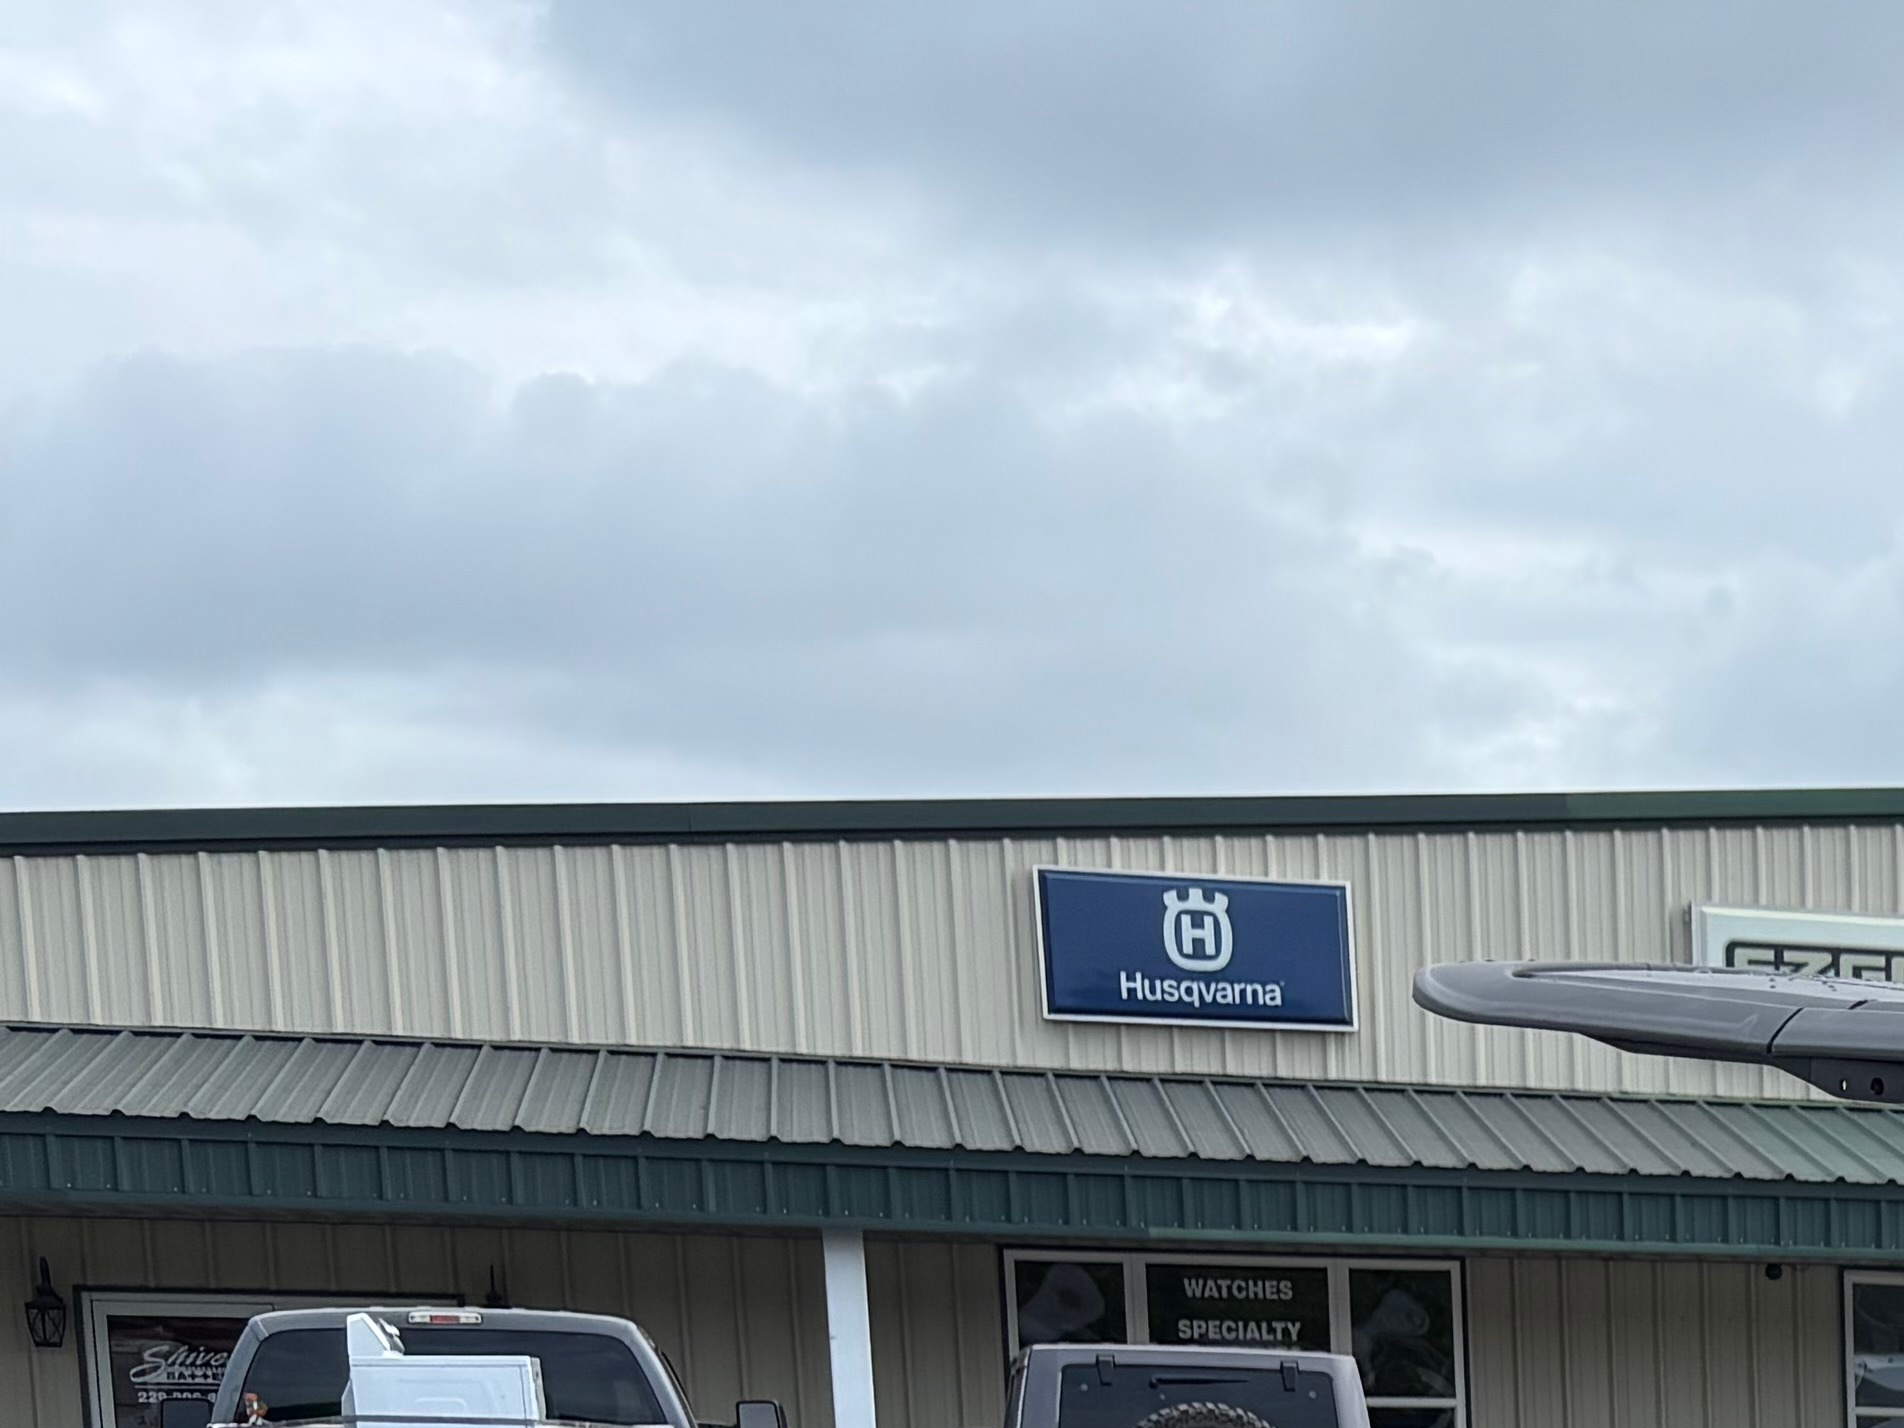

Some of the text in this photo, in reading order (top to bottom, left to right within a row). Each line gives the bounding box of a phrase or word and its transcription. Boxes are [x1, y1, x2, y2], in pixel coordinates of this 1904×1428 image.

[1119, 970, 1283, 1008] Husqvarna
[1183, 1277, 1294, 1300] WATCHES
[1177, 1318, 1301, 1342] SPECIALTY
[130, 1345, 228, 1383] Shive
